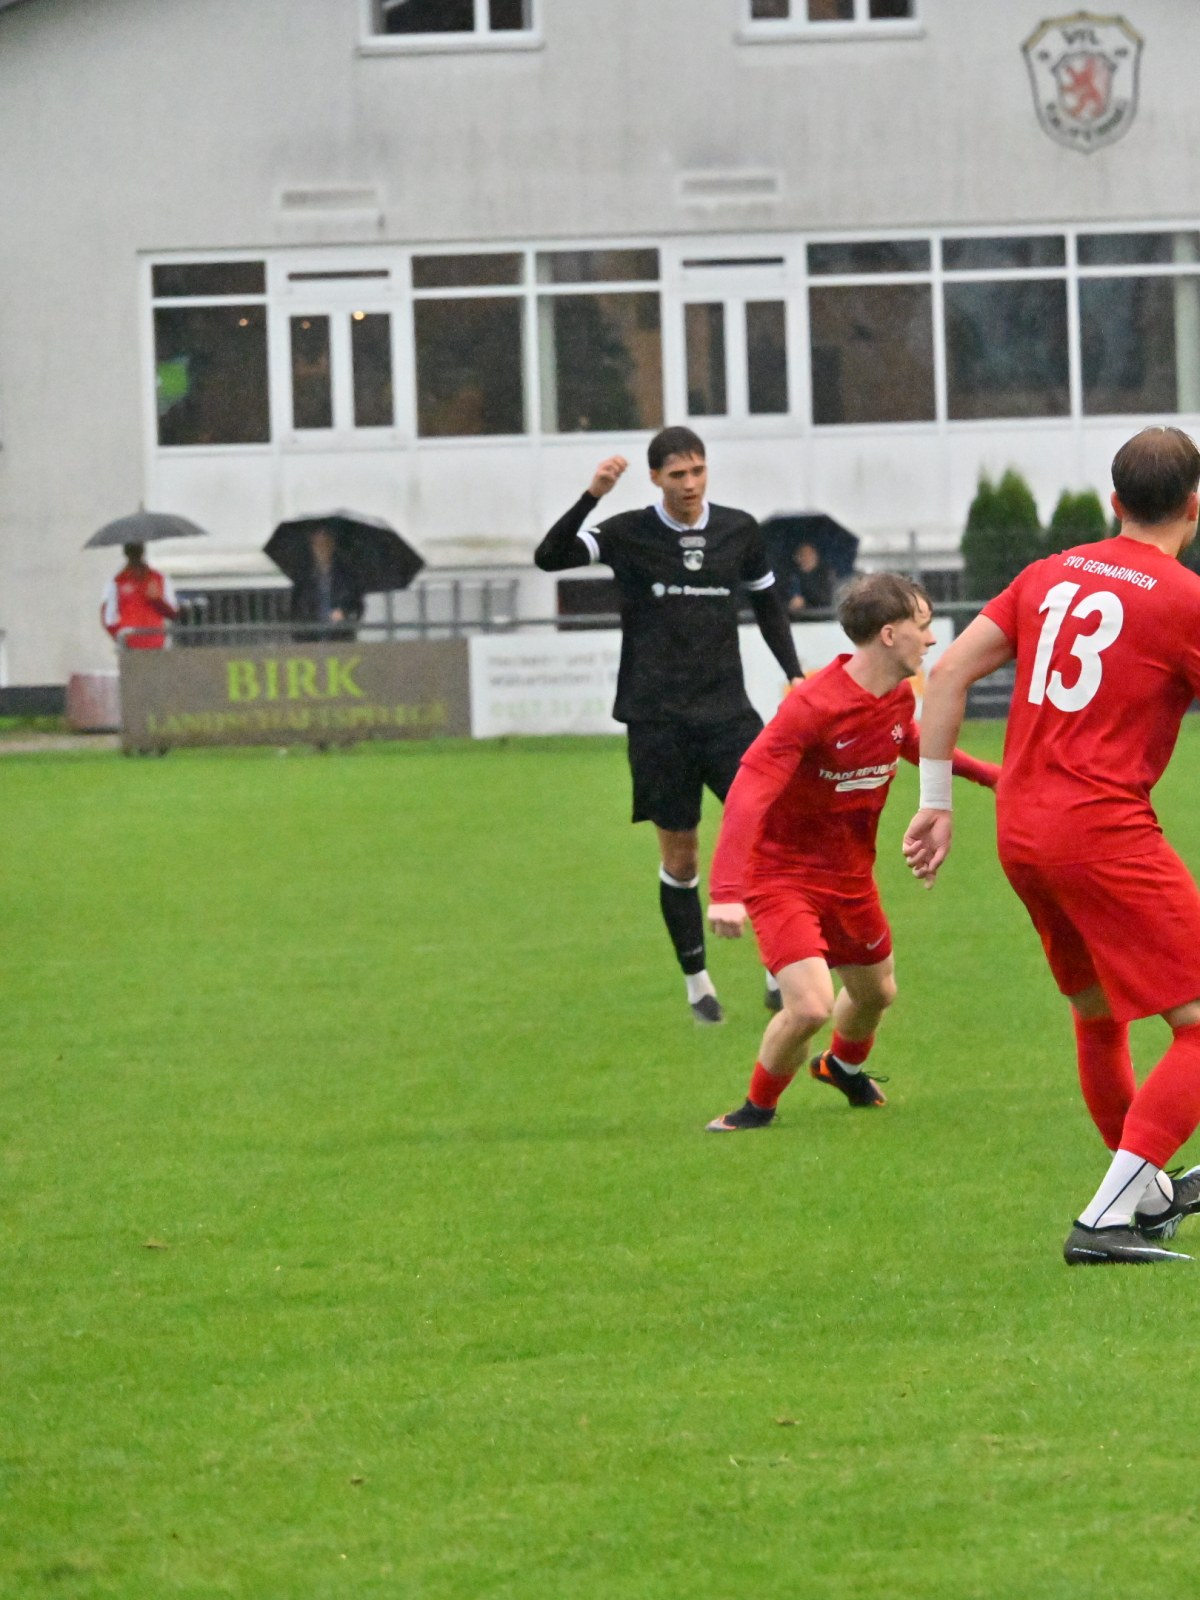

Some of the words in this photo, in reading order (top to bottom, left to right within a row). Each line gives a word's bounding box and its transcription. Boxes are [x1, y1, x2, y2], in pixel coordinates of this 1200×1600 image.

[1083, 559, 1158, 591] GERMARINGEN
[1028, 580, 1124, 713] 13
[227, 656, 366, 703] BIRK
